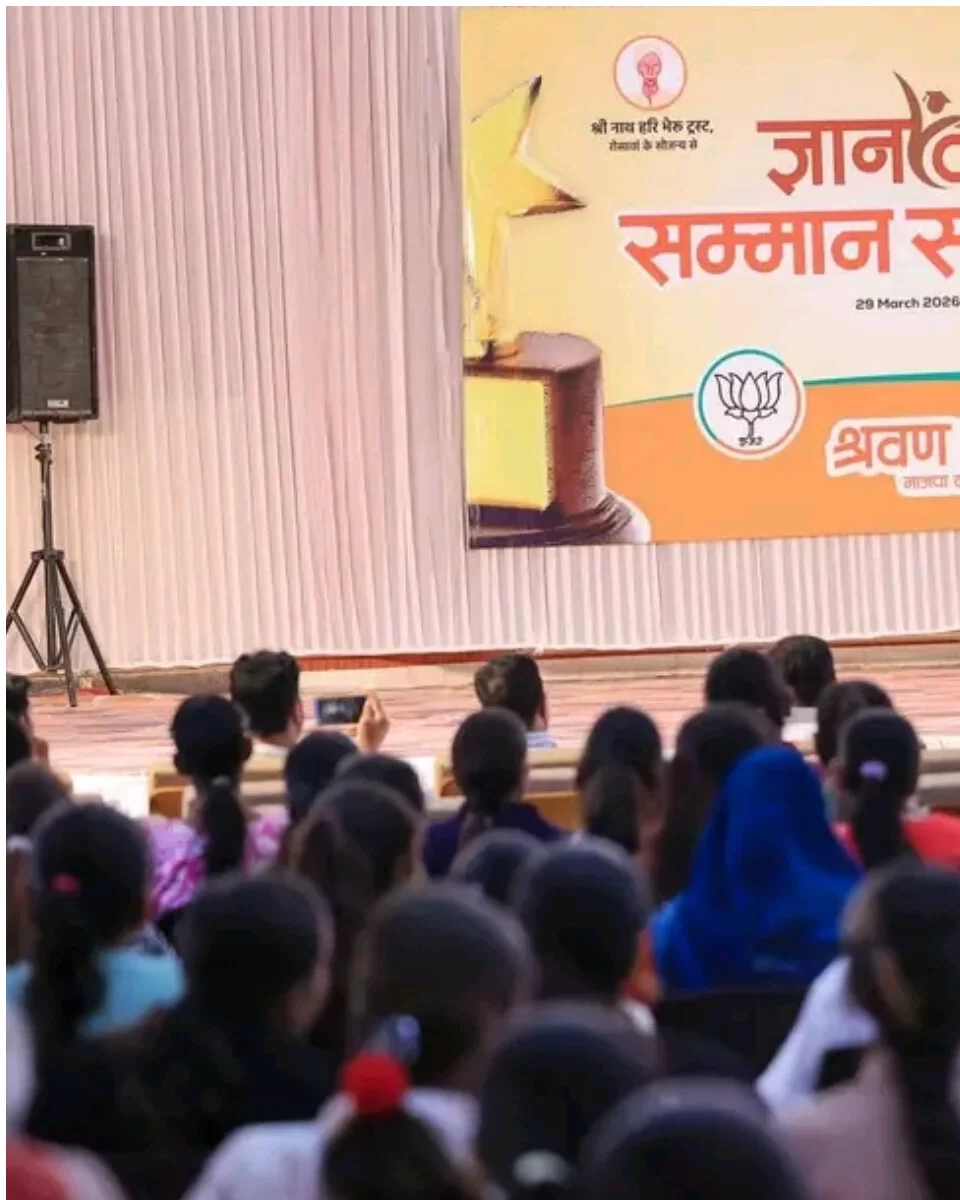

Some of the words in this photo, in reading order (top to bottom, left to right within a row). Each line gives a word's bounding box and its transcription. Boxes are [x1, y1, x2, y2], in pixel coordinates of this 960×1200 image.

[591, 117, 607, 135] श्री
[610, 121, 635, 134] नाथ
[638, 117, 660, 135] हरि
[643, 139, 652, 152] के
[618, 209, 894, 287] सम्मान
[855, 298, 875, 311] 29
[877, 297, 920, 311] March
[922, 296, 960, 310] 2026
[834, 424, 952, 470] श्रवण
